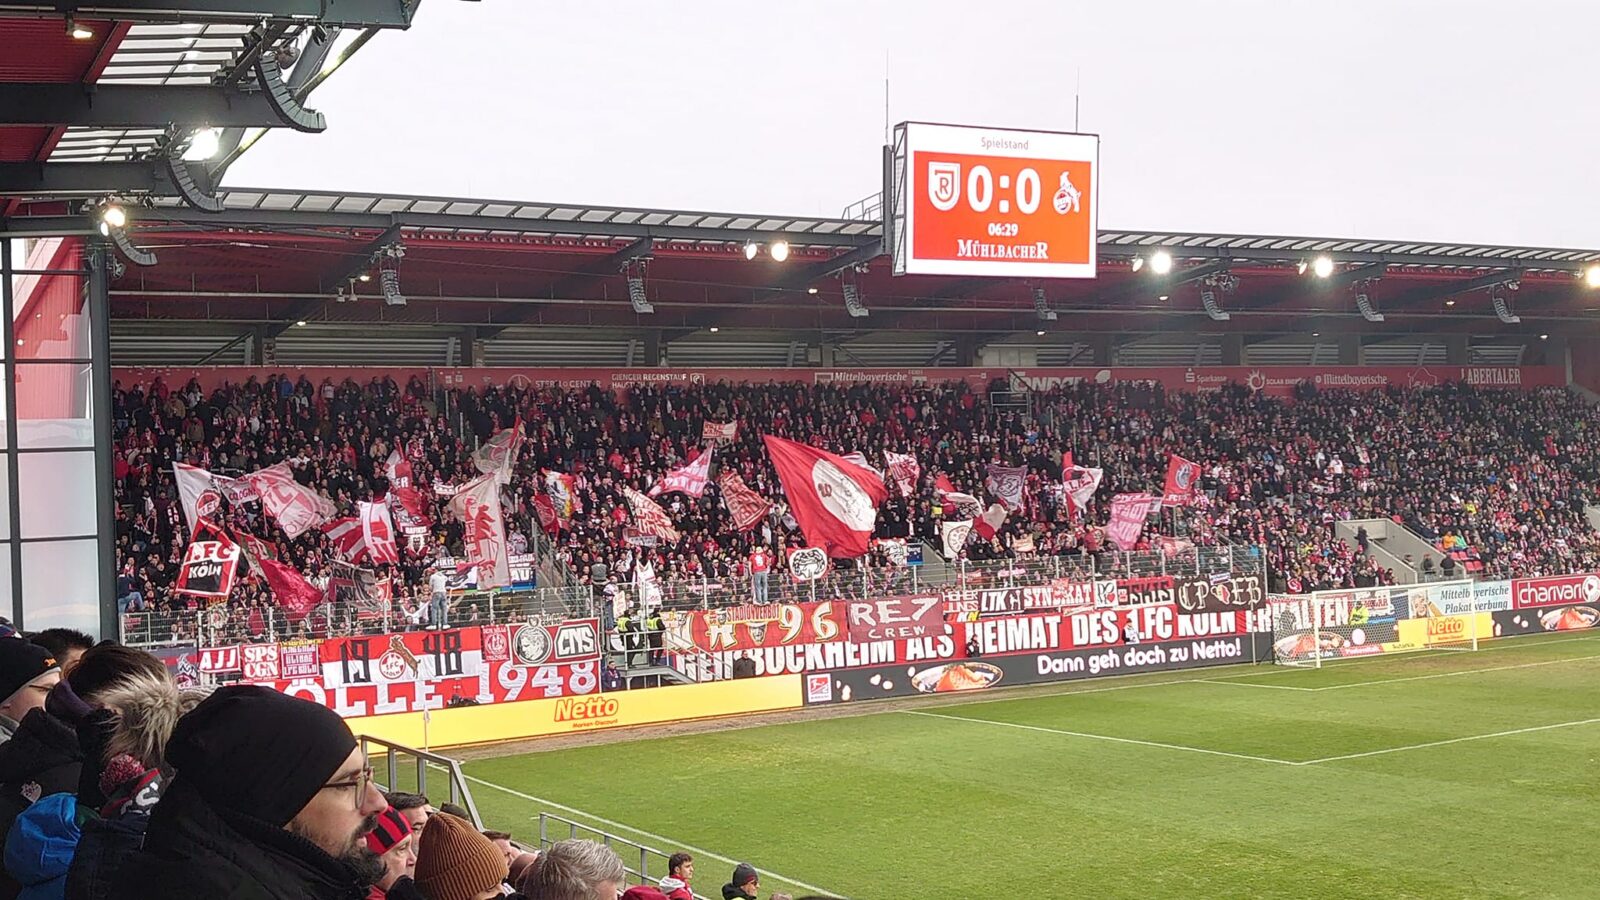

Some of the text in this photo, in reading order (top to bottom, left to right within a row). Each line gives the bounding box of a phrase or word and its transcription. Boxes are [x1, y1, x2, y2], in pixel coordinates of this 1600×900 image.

[981, 136, 1029, 151] Spielstand
[967, 164, 1041, 214] 0:0
[988, 222, 1018, 236] 06:29
[957, 238, 1048, 259] MÜHLBACHER
[834, 371, 907, 382] Mittelbayerische
[1324, 373, 1388, 385] Mittelbayerische
[186, 543, 235, 562] 1.FC
[188, 561, 222, 579] KÖLN
[981, 590, 1009, 612] LTK
[1023, 583, 1092, 609] SYNKAT
[1440, 585, 1509, 600] Mittelbyerische
[1519, 580, 1583, 604] charivari
[868, 625, 926, 638] CREW
[906, 624, 954, 661] ALS
[965, 614, 1061, 654] HEIMAT
[1071, 610, 1119, 646] DES
[1428, 618, 1464, 635] Netto
[244, 645, 278, 663] SPS
[1037, 637, 1241, 675] Dann geh doch zu Netto!
[244, 661, 278, 678] CGN
[476, 660, 597, 704] 1948
[554, 696, 619, 722] Netto
